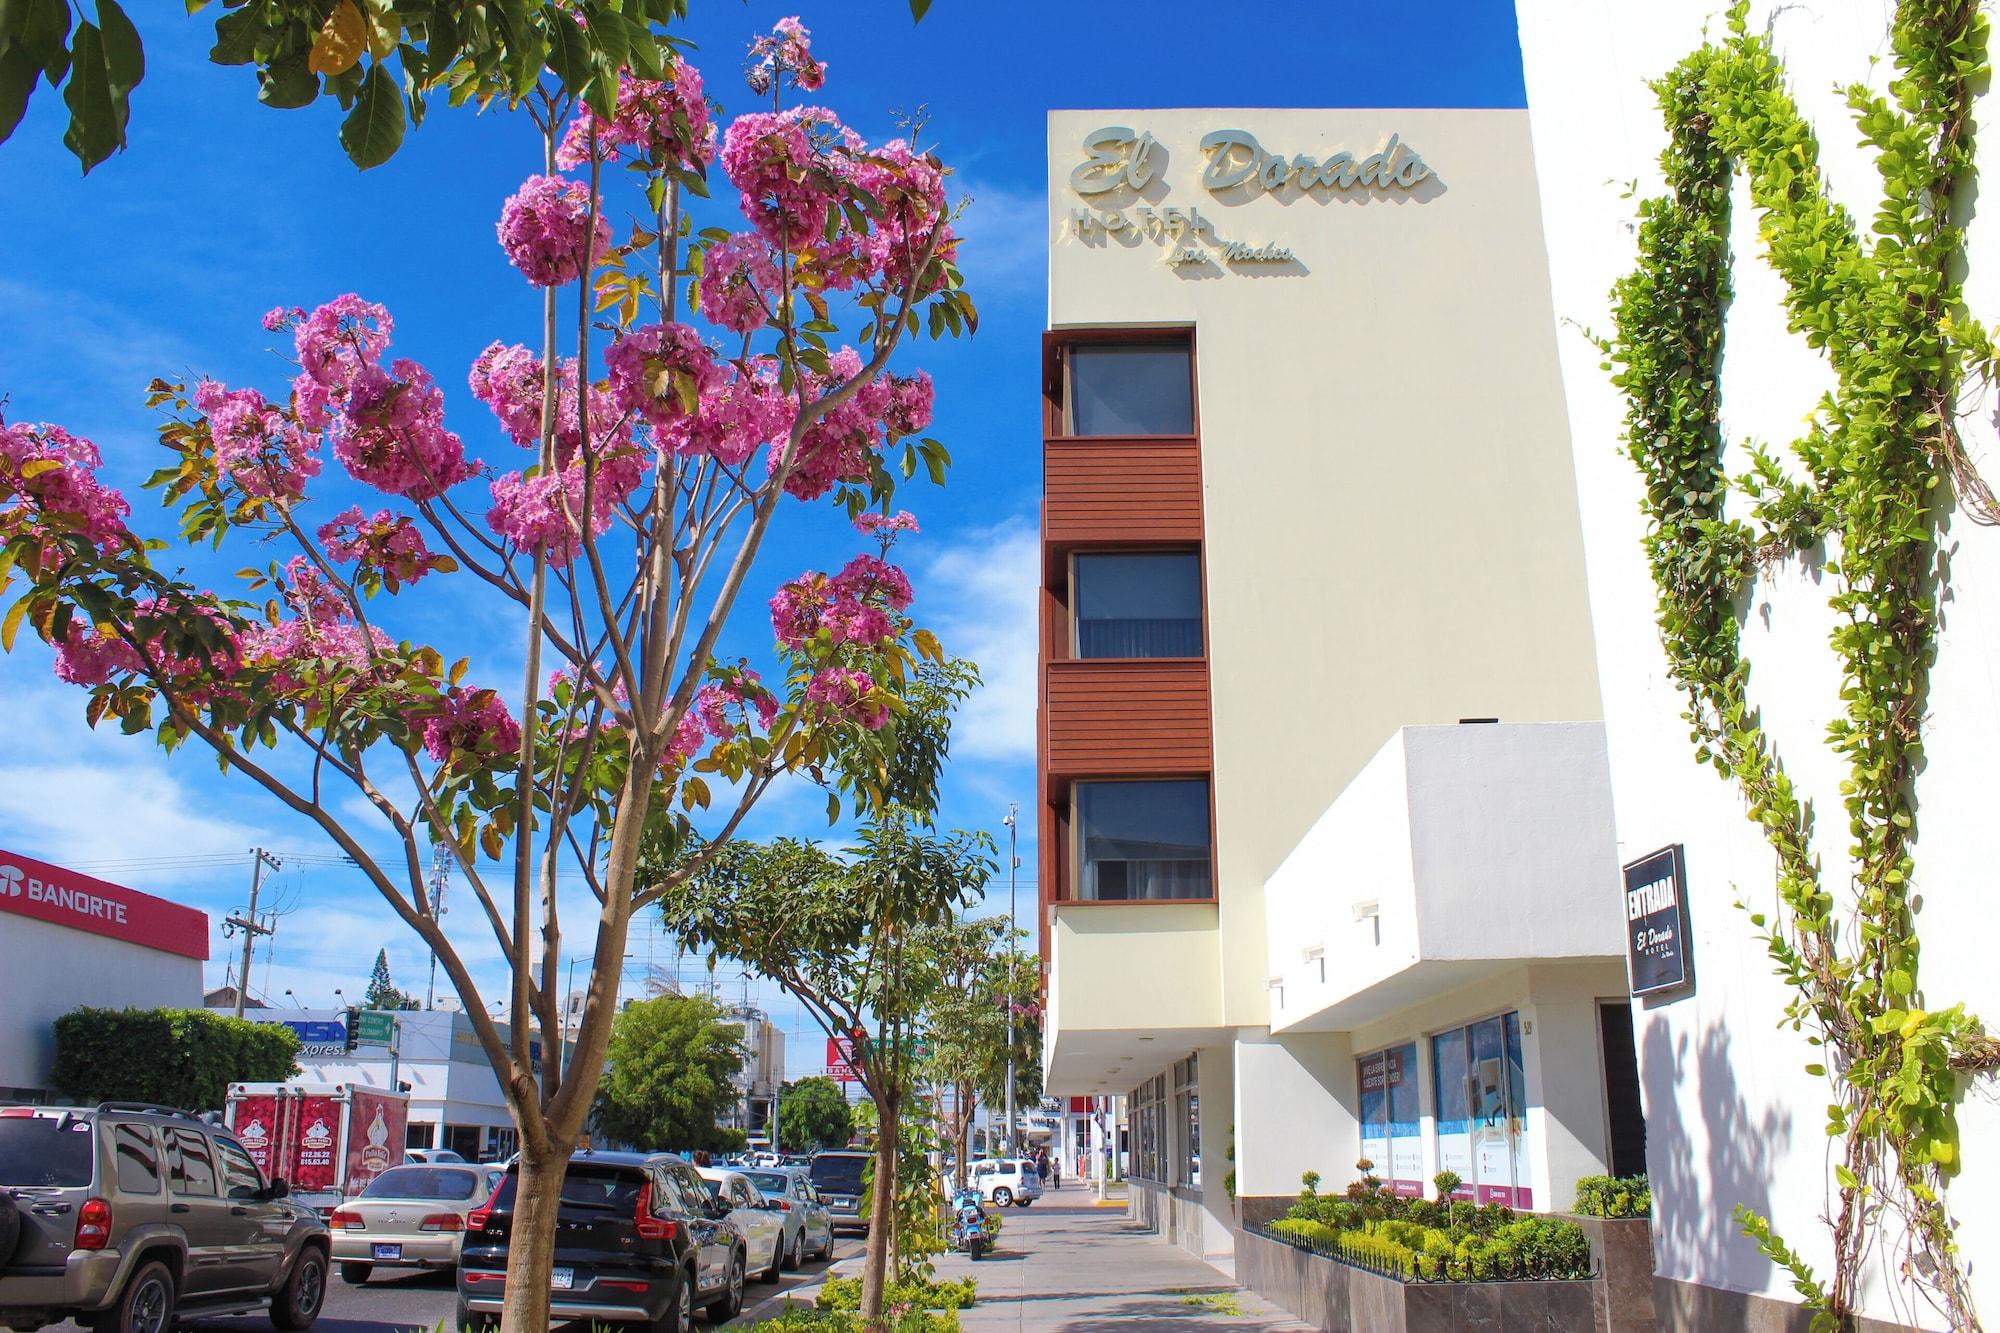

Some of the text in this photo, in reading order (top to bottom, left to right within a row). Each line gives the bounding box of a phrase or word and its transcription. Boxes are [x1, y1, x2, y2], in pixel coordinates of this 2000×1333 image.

[1070, 127, 1431, 194] El Dorado
[1070, 207, 1206, 231] HOTEL
[1166, 241, 1294, 265] Los Mochis
[28, 878, 128, 924] BANORTE
[1627, 876, 1676, 921] ENTRADA
[1637, 925, 1672, 951] El Dorado
[1645, 943, 1669, 956] HOTEL
[296, 1044, 347, 1058] xpress
